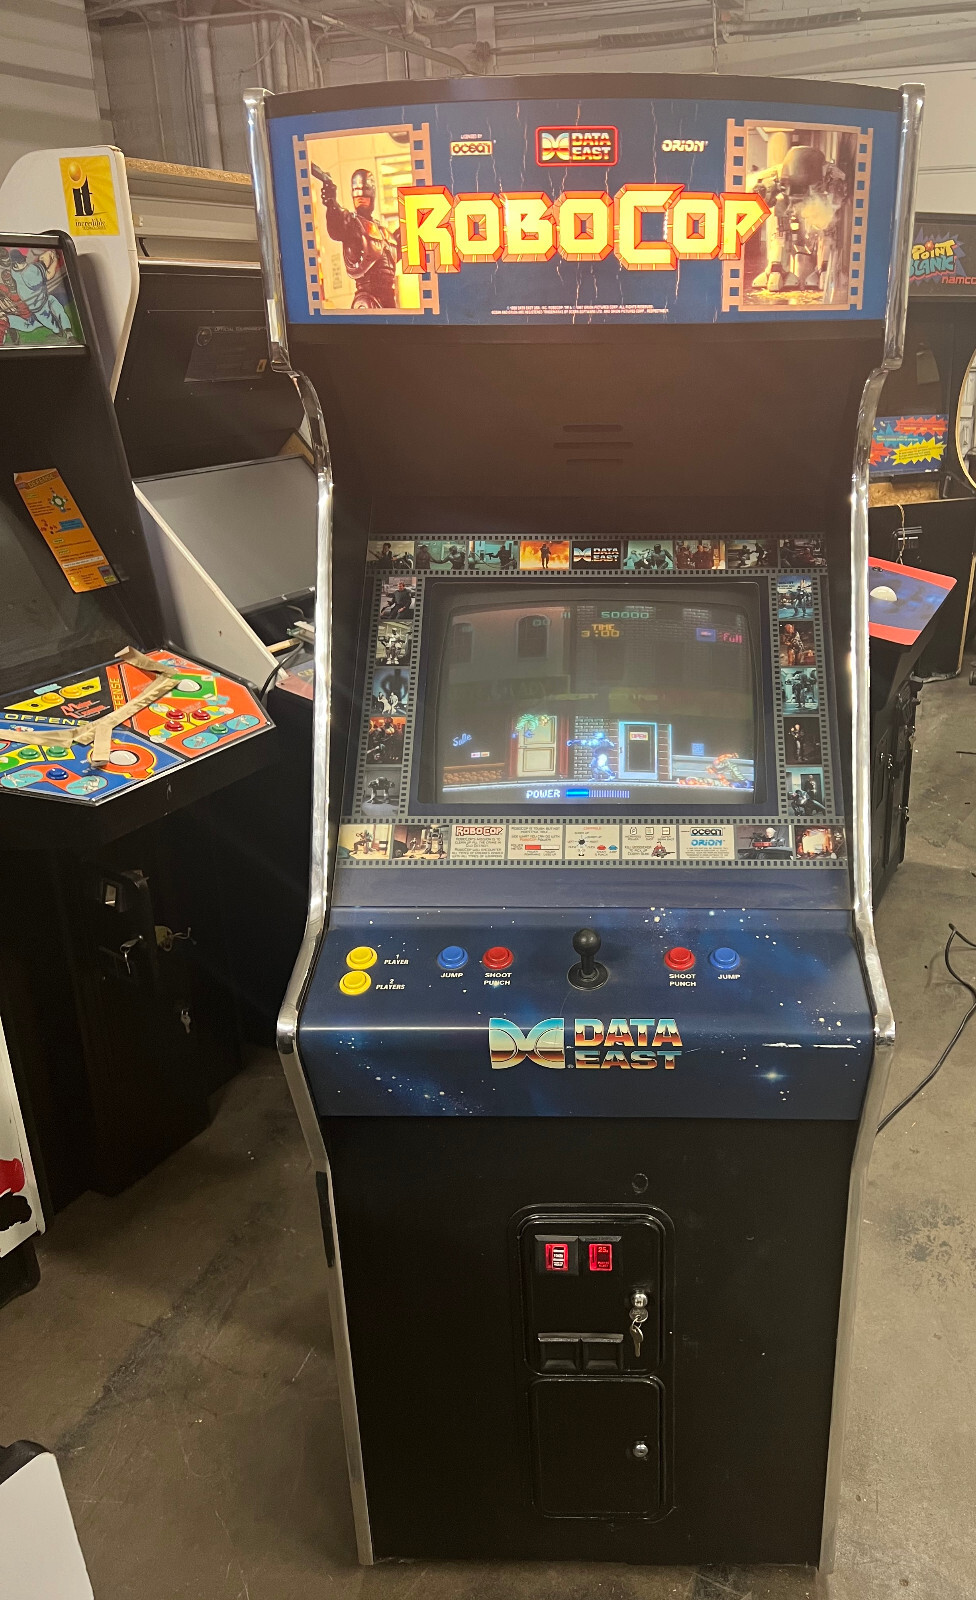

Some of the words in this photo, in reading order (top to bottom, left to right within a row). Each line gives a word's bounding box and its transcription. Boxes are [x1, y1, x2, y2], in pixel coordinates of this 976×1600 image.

[571, 132, 611, 146] DATA
[572, 146, 611, 160] EAST
[593, 547, 619, 555] DATA
[601, 611, 649, 619] 50000
[592, 623, 615, 631] TIME
[5, 713, 89, 726] OFFENS
[526, 789, 560, 799] POWER
[691, 828, 722, 836] ocean
[574, 1018, 683, 1047] DATA
[574, 1050, 682, 1070] EAST
